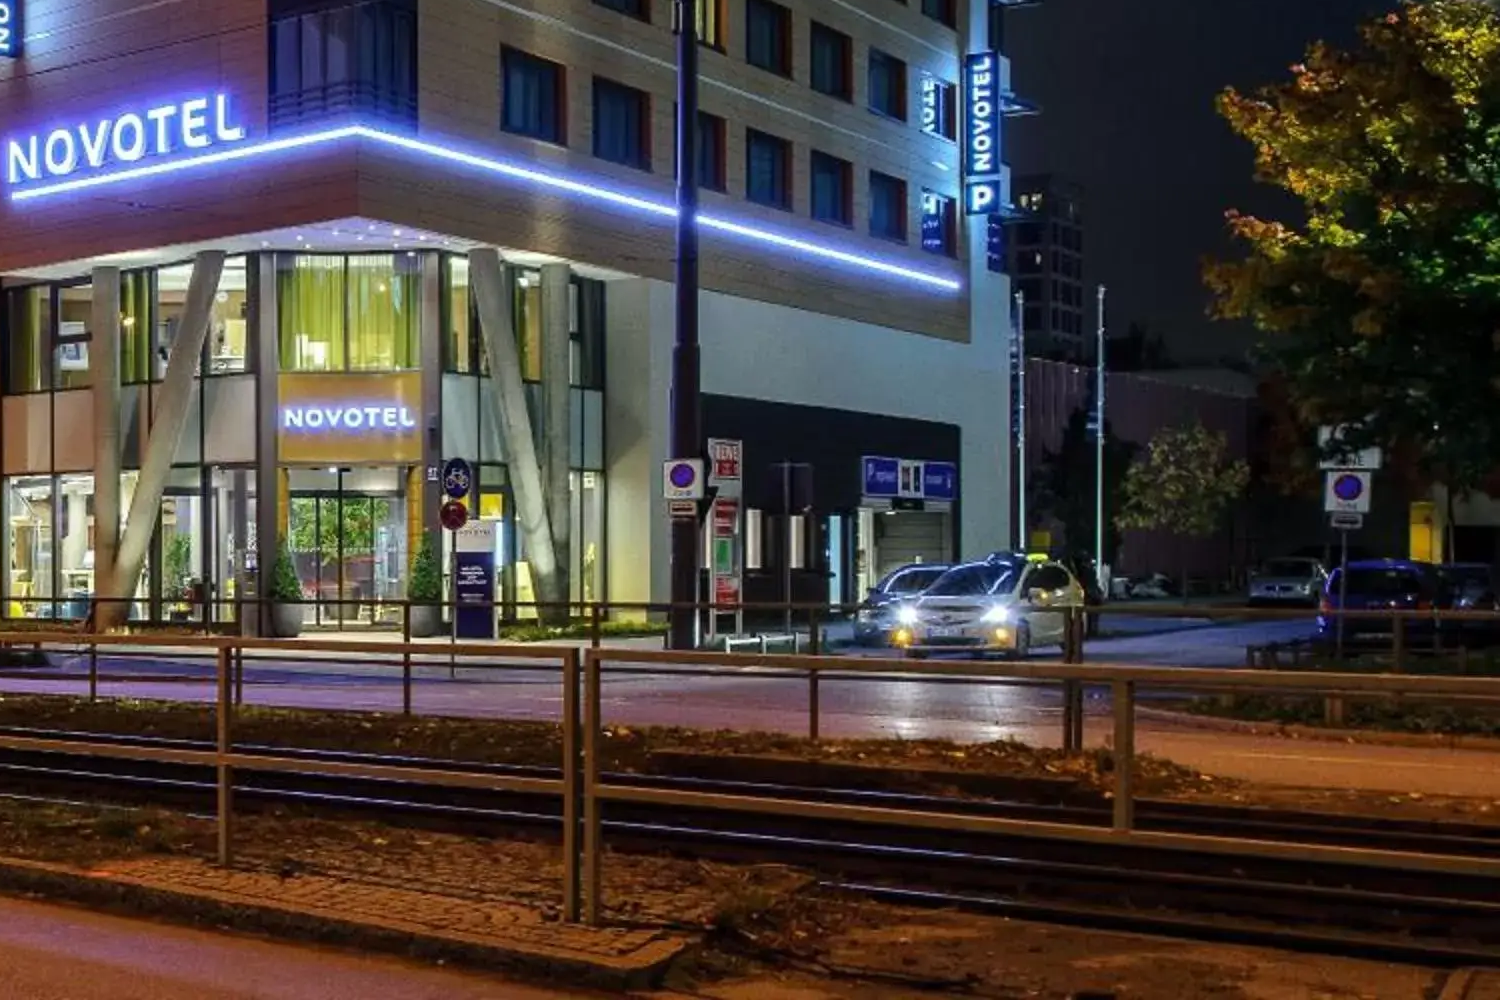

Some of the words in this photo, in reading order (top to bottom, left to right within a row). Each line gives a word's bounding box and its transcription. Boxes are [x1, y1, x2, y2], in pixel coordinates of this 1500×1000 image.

[7, 93, 245, 183] NOVOTEL
[973, 57, 991, 171] NOVOTEL
[972, 184, 994, 211] P
[284, 407, 415, 428] NOVOTEL
